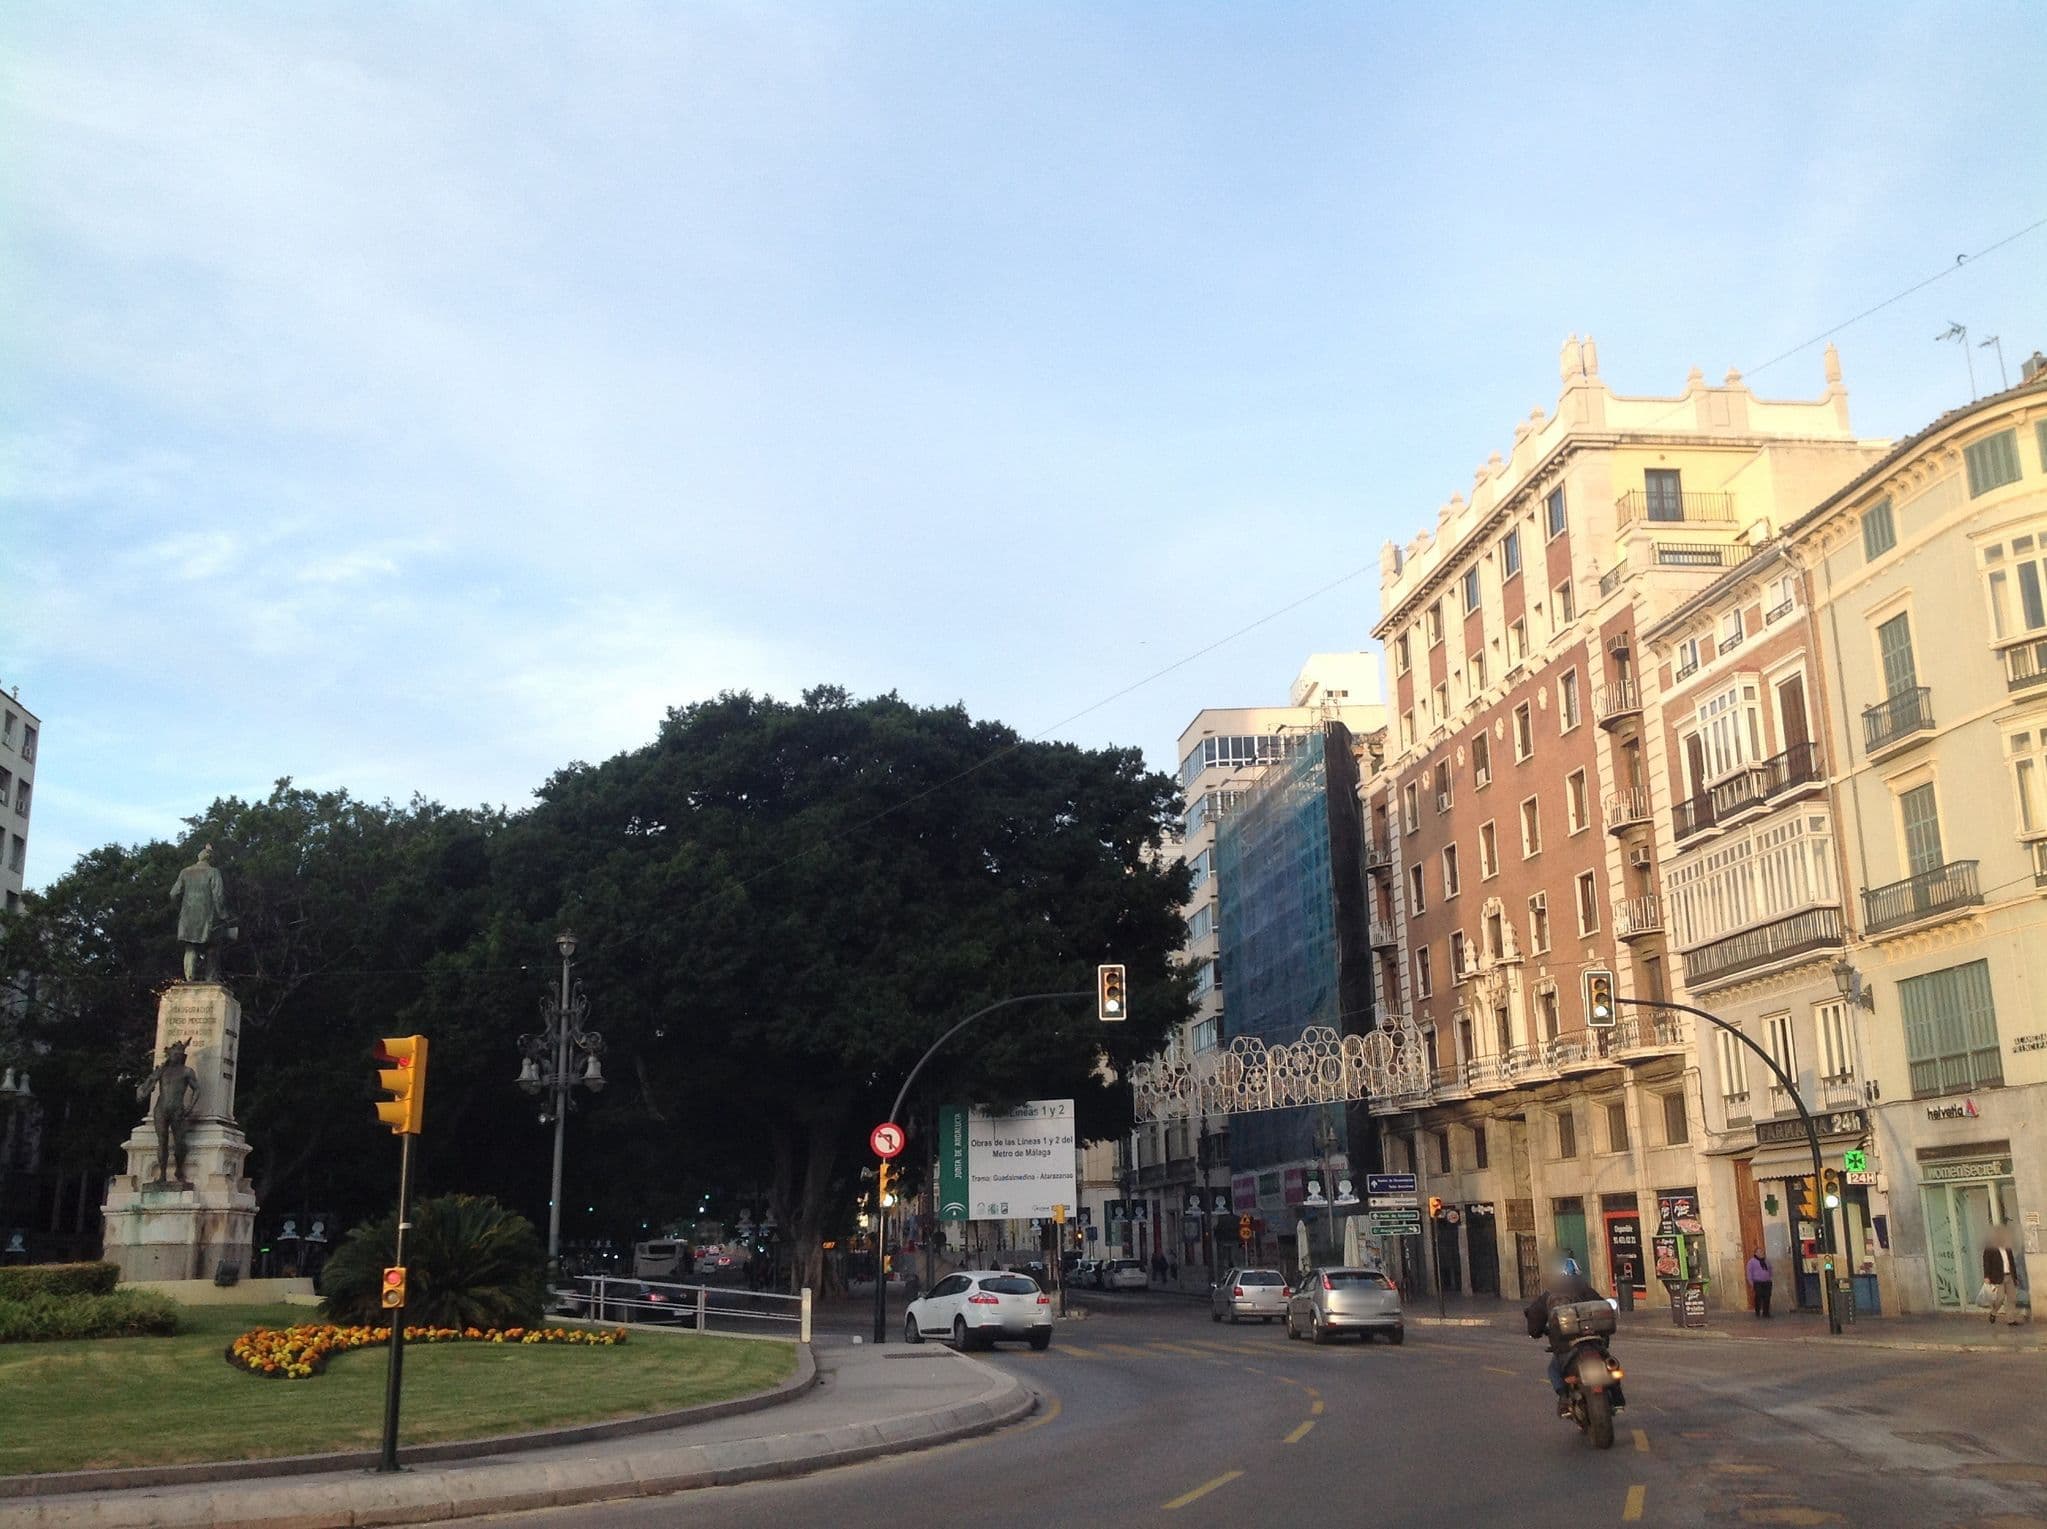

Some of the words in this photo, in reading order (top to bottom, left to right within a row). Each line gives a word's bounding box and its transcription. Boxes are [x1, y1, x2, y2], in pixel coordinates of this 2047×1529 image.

[1042, 1105, 1047, 1116] 1
[1050, 1107, 1056, 1118] y
[1059, 1104, 1065, 1115] 2
[1927, 1102, 1964, 1121] helvetia
[1760, 1118, 1828, 1142] FARMAIA
[1831, 1112, 1861, 1133] 24h
[971, 1139, 992, 1148] Obras
[994, 1138, 1003, 1146] de
[1005, 1138, 1015, 1146] las
[1055, 1136, 1060, 1144] 2
[1062, 1136, 1073, 1144] del
[992, 1149, 1013, 1158] Metro
[1014, 1149, 1023, 1158] de
[1025, 1147, 1051, 1158] Málaga
[1851, 1173, 1875, 1183] 24H
